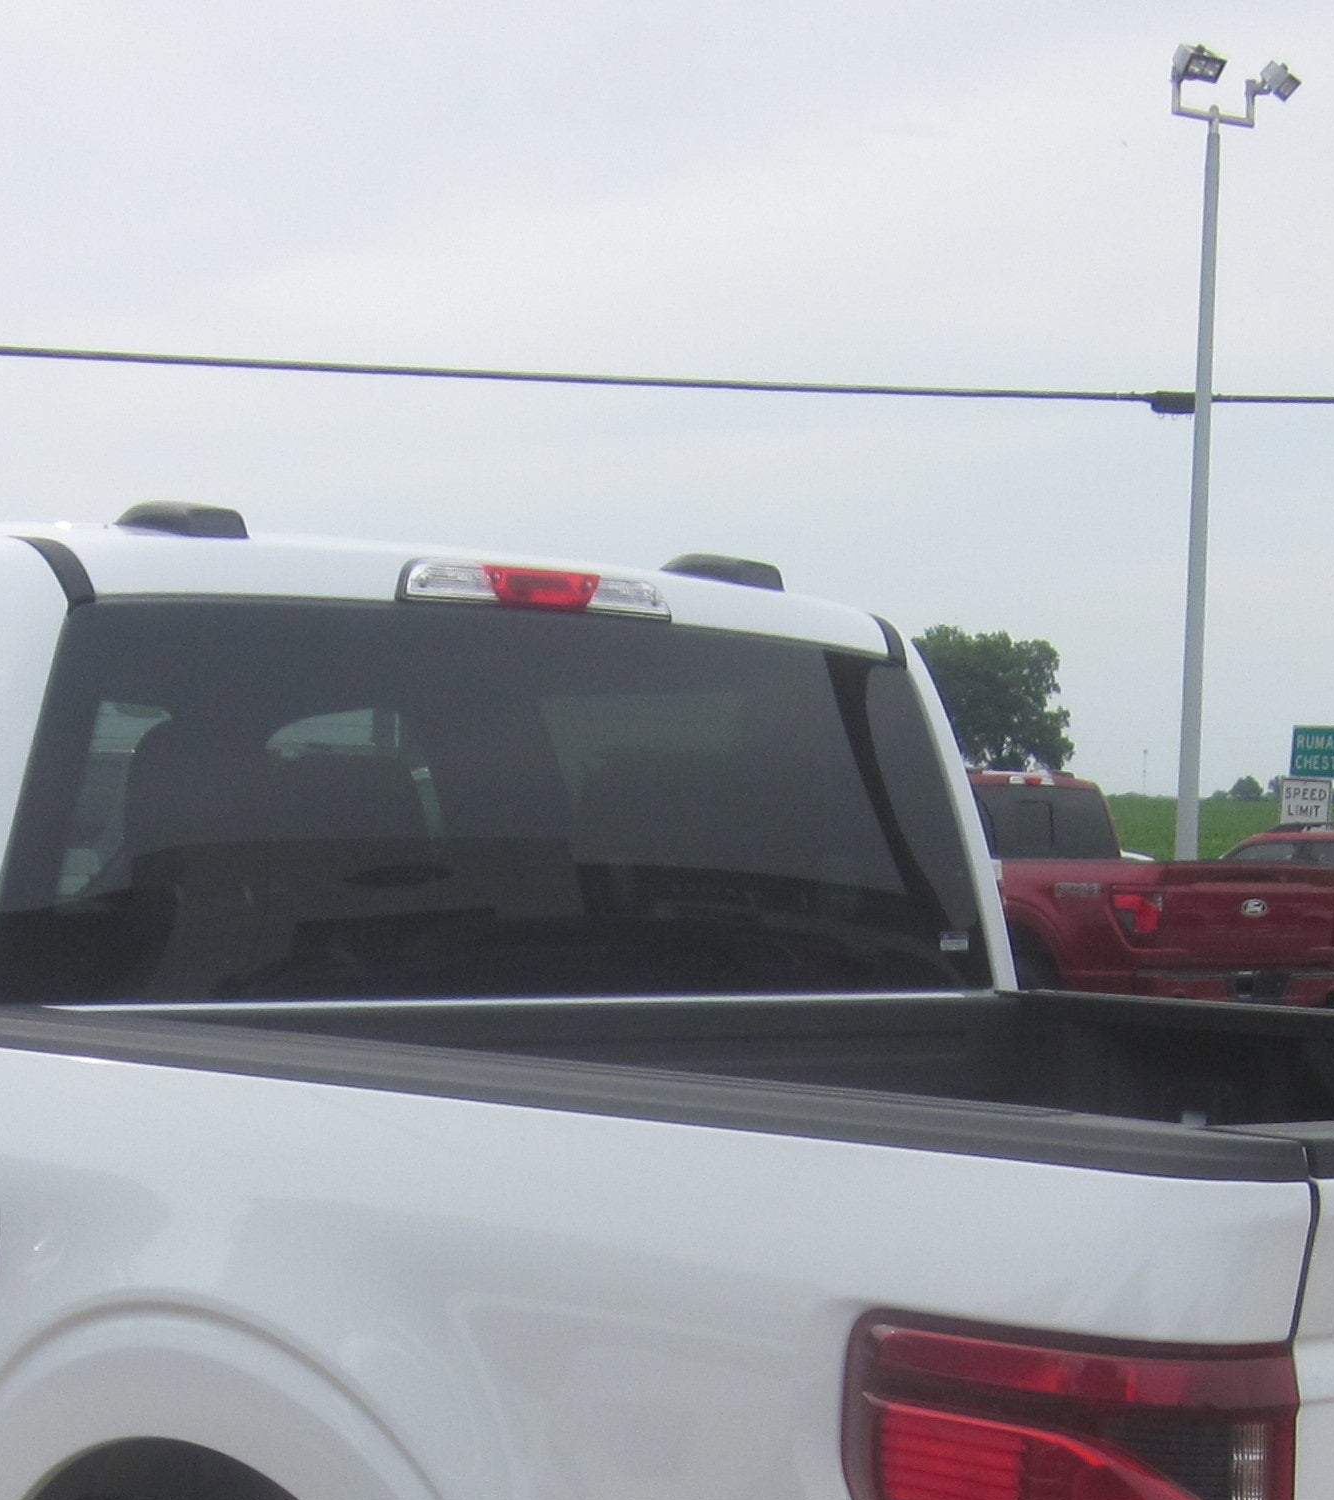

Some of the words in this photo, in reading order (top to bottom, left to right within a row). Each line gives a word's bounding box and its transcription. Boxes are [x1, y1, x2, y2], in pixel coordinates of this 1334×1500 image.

[1296, 736, 1334, 750] RUMA
[1285, 787, 1327, 801] SPEED
[1288, 804, 1321, 816] LIMIT
